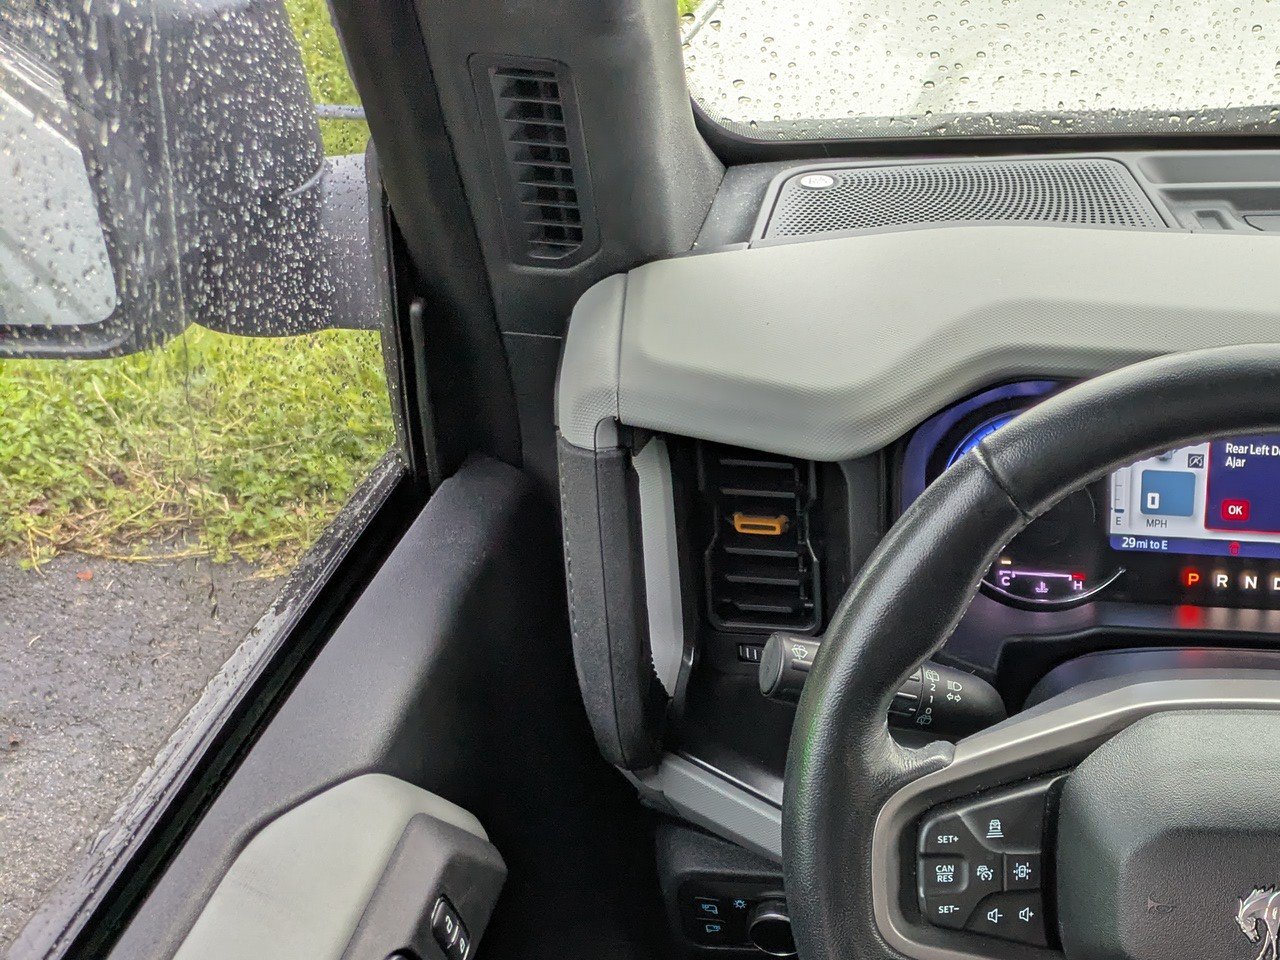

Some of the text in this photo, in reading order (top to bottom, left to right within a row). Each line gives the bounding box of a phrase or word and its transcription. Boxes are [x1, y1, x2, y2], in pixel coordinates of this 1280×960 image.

[1225, 443, 1249, 454] Rear
[1249, 444, 1270, 456] Left
[1225, 456, 1247, 469] Ajar
[1147, 492, 1160, 509] 0
[1228, 505, 1243, 515] OK
[1115, 517, 1122, 526] E
[1146, 519, 1168, 529] MPH
[1150, 540, 1161, 550] to
[1161, 540, 1169, 550] E
[1001, 576, 1011, 586] C
[1073, 580, 1083, 590] H
[1188, 573, 1200, 586] P
[1216, 574, 1229, 588] R
[1245, 576, 1258, 590] N
[930, 683, 936, 692] 2
[930, 695, 934, 704] 1
[925, 707, 932, 715] 0
[937, 835, 959, 844] SET+
[935, 864, 955, 873] CAN
[937, 874, 954, 883] RES
